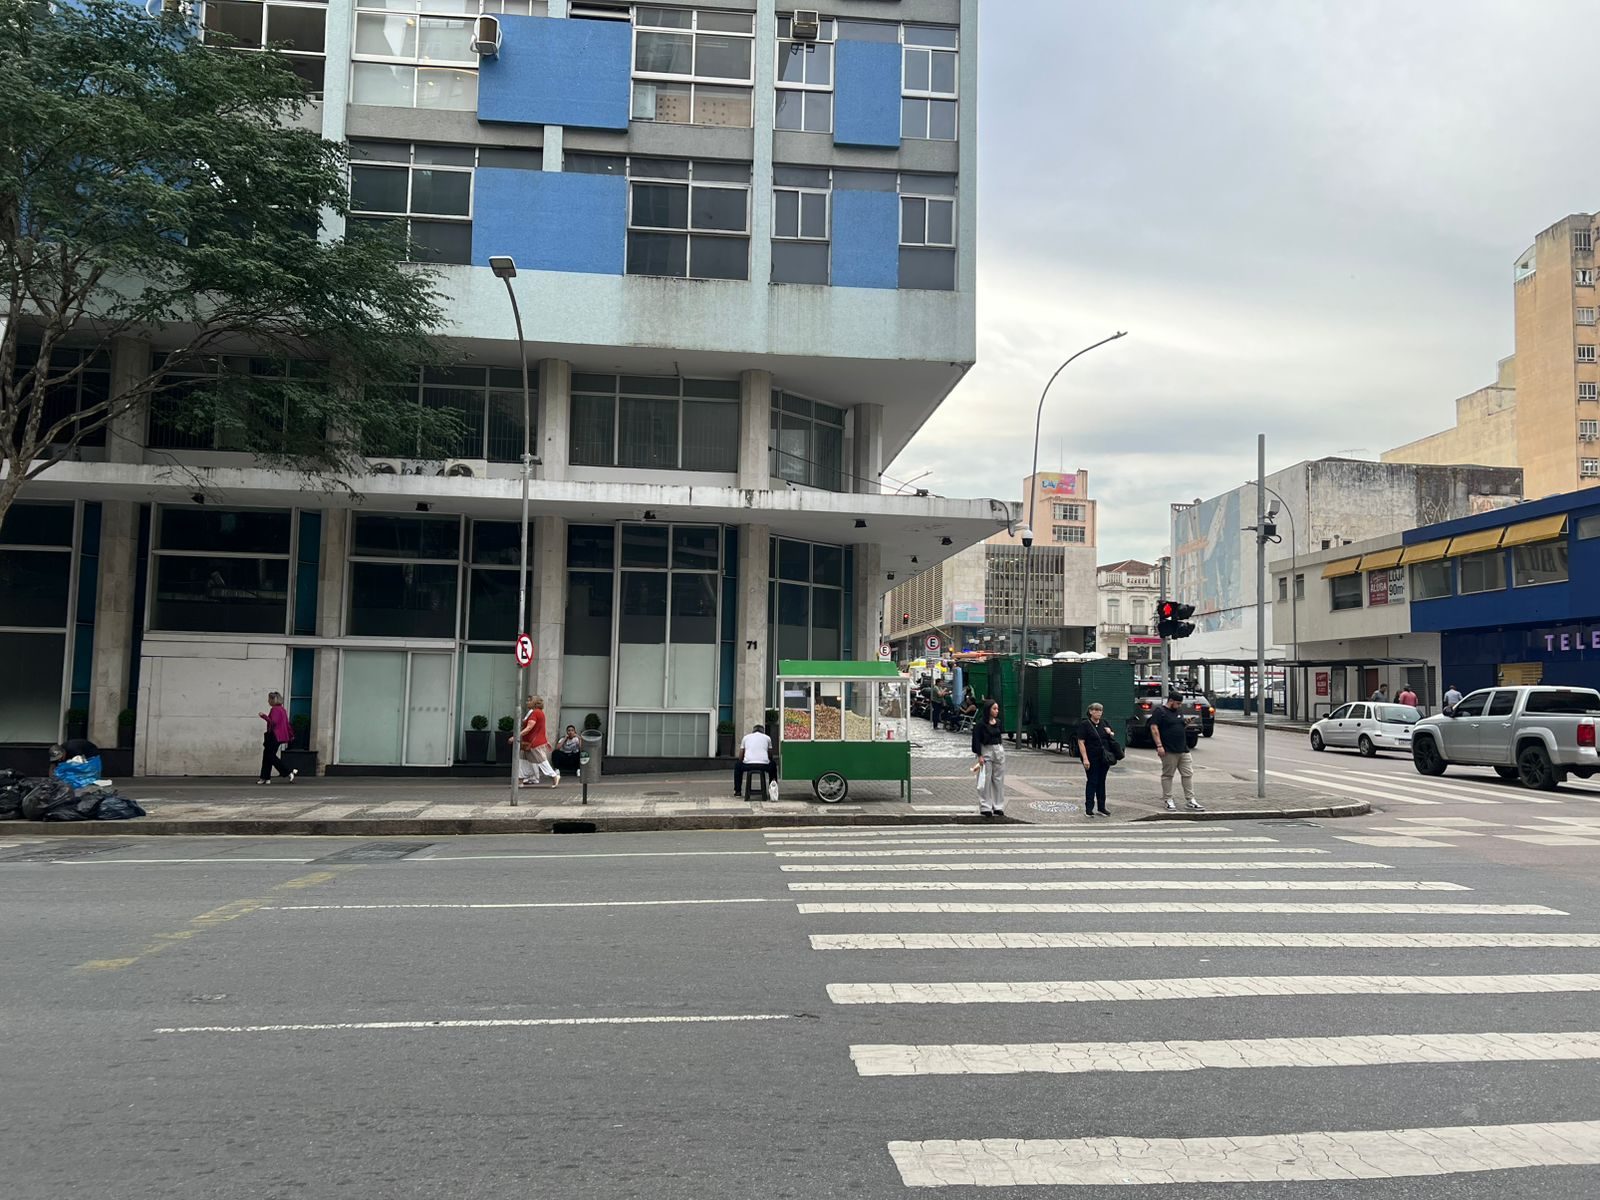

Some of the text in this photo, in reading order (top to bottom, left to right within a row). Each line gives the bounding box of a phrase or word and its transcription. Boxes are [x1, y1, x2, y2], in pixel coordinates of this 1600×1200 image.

[746, 641, 757, 650] 71
[930, 638, 936, 647] E
[1544, 631, 1600, 651] TELE
[521, 641, 528, 659] E
[882, 646, 887, 654] E
